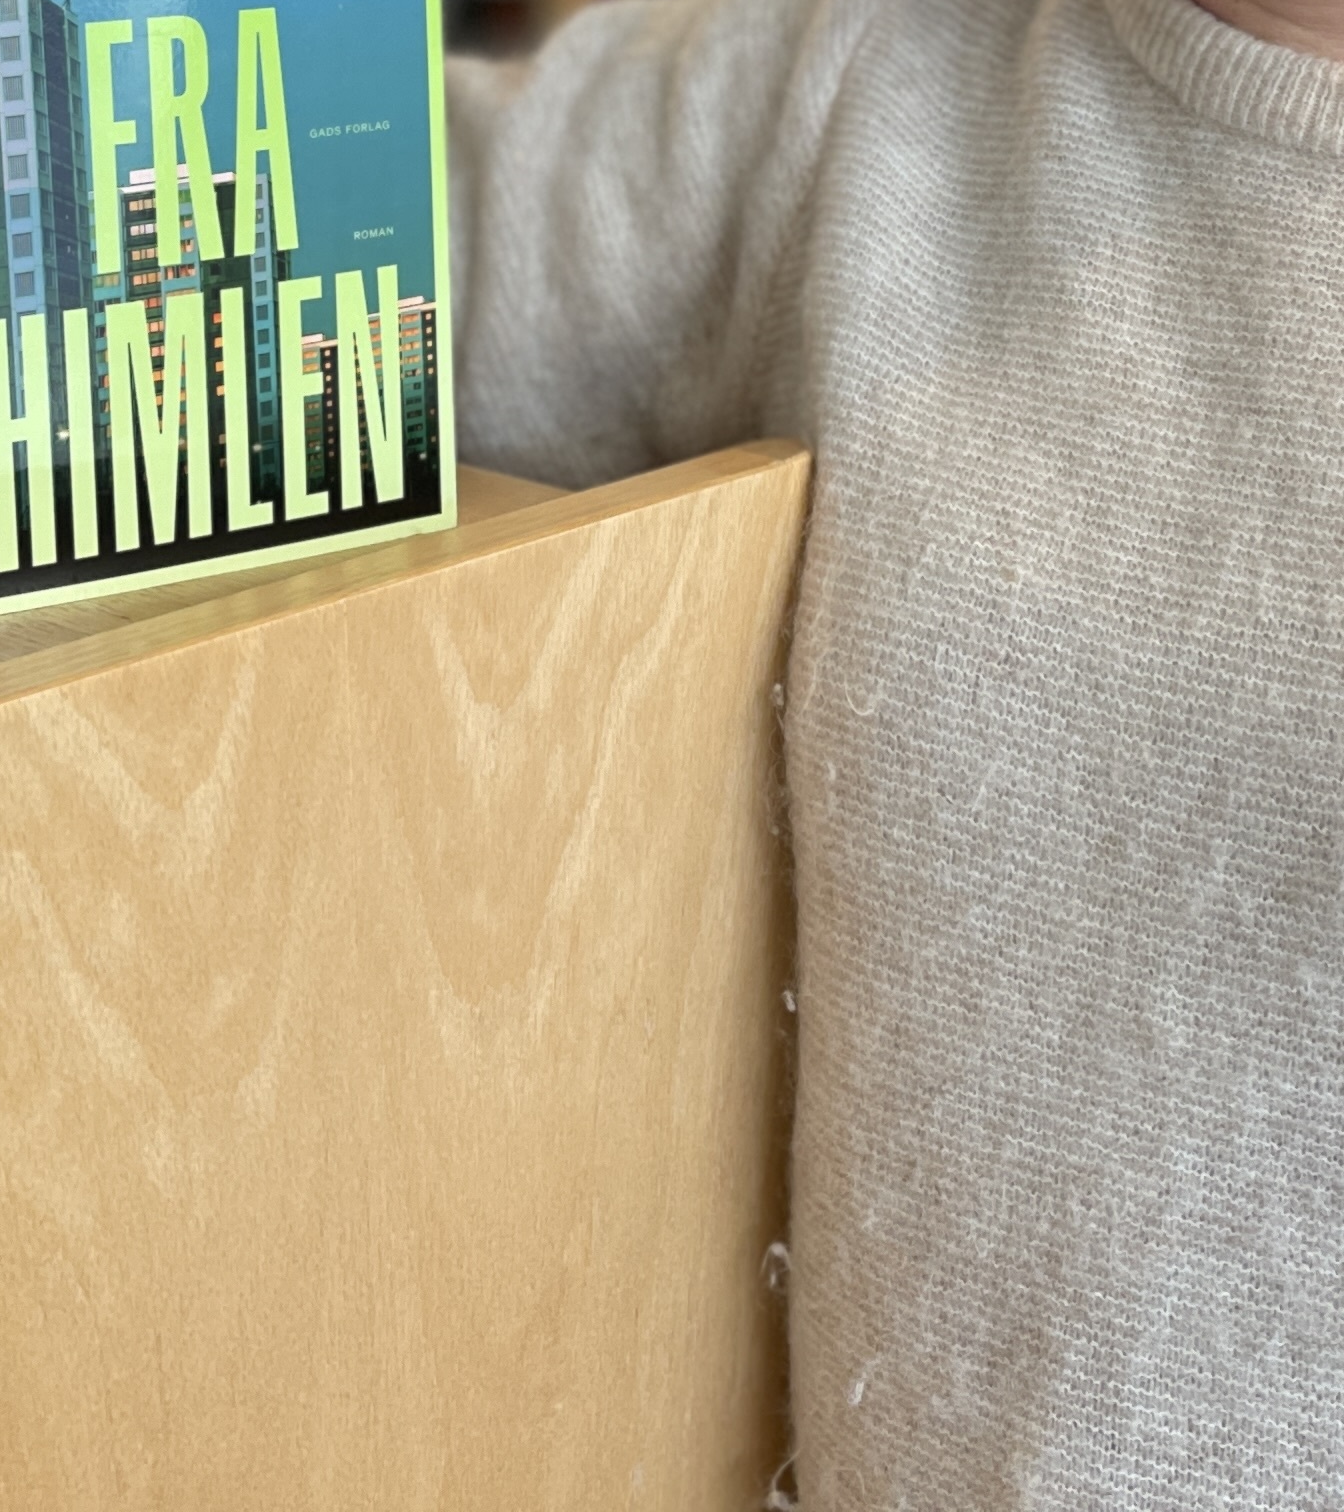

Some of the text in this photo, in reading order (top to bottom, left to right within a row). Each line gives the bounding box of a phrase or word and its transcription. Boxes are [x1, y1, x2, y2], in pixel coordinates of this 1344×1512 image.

[309, 120, 391, 139] GADS FORLAG
[84, 7, 299, 275] FRA
[353, 227, 394, 240] ROMAN
